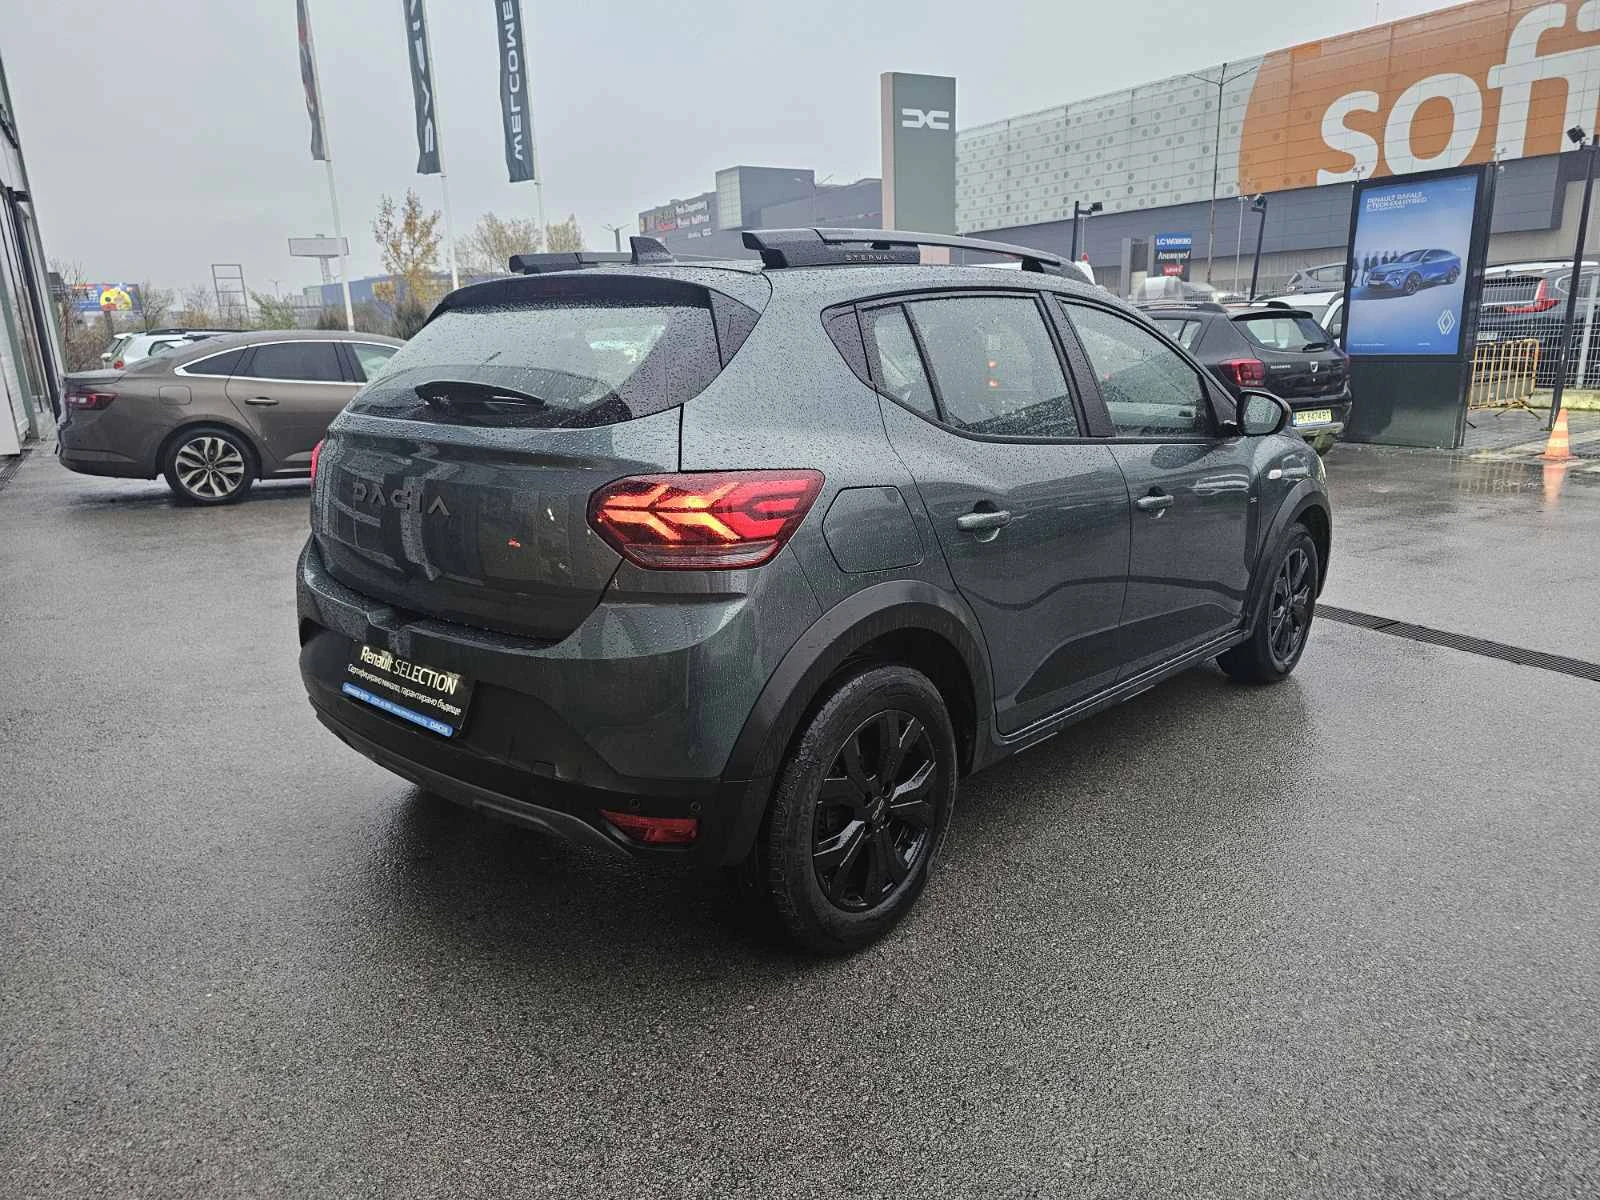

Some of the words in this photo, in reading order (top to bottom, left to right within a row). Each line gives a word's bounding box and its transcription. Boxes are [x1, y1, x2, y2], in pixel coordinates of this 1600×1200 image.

[352, 481, 451, 517] DACIA
[361, 646, 393, 672] Renault
[393, 659, 458, 695] SELECTION
